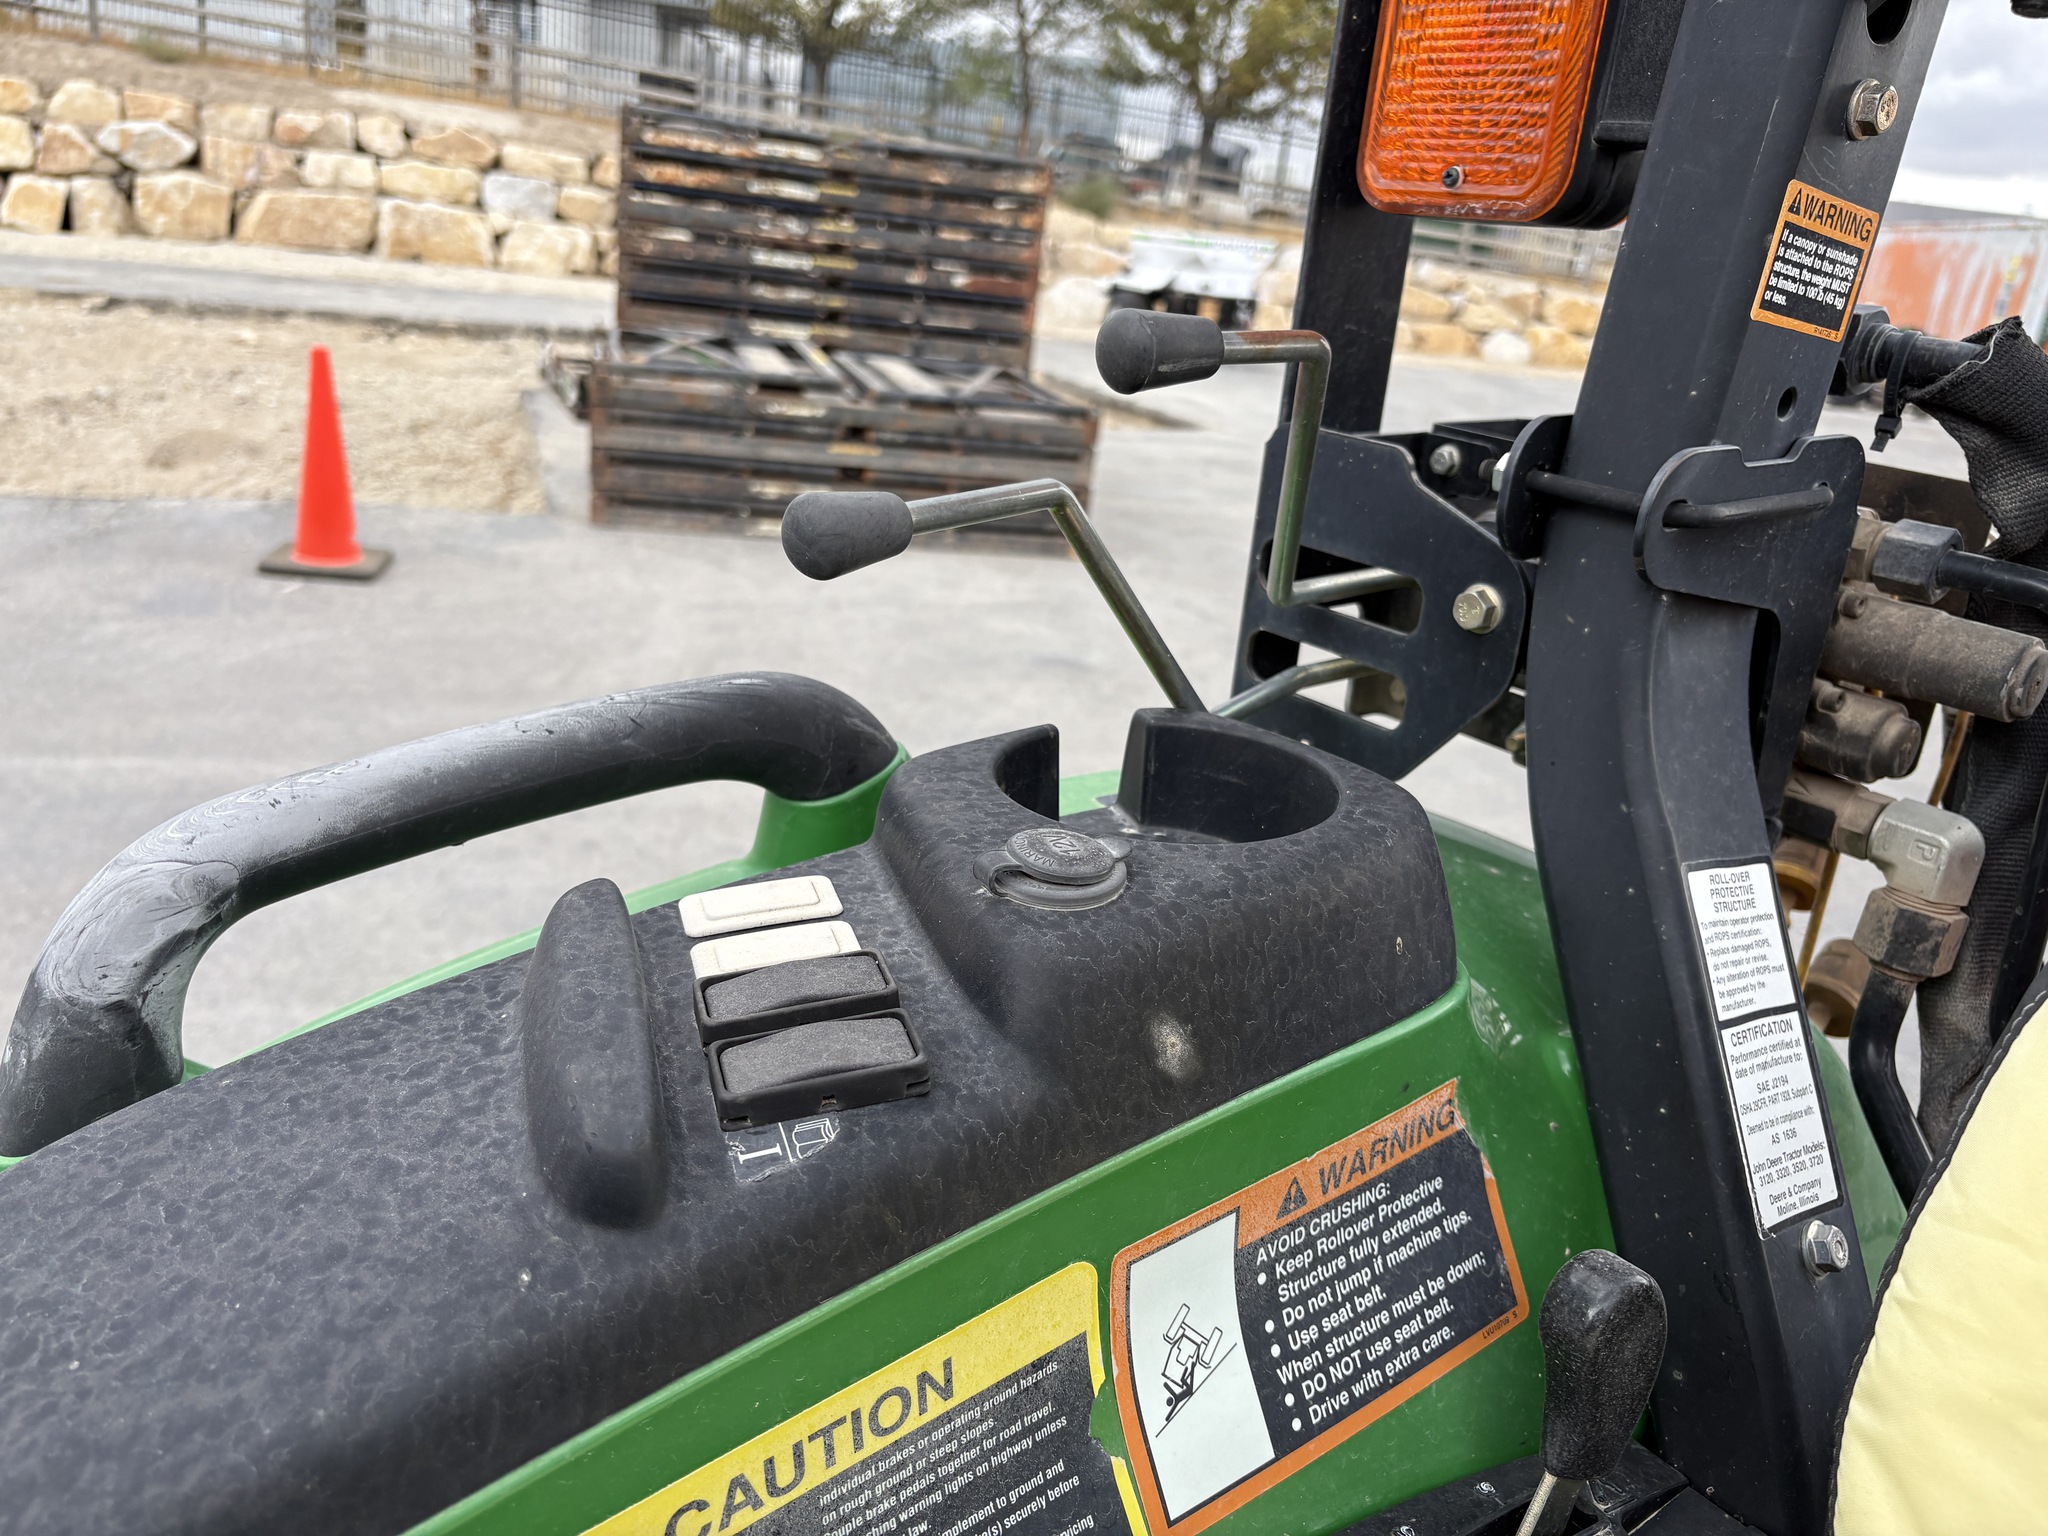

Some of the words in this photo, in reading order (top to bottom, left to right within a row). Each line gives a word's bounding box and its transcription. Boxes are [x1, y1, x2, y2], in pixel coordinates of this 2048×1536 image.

[1804, 194, 1872, 242] WARNING
[1778, 244, 1784, 256] is
[1785, 248, 1814, 266] attached
[1814, 257, 1821, 269] to
[1822, 260, 1833, 273] the
[1834, 264, 1854, 280] ROPS
[1782, 229, 1789, 241] If
[1788, 234, 1793, 243] a
[1793, 236, 1817, 254] canopy
[1818, 243, 1826, 254] or
[1826, 248, 1858, 266] sunshade
[1769, 273, 1777, 286] be
[1777, 276, 1799, 293] limited
[1798, 284, 1805, 295] to
[1806, 286, 1818, 299] 100
[1817, 288, 1824, 301] lb
[1823, 292, 1835, 305] (45
[1834, 295, 1846, 310] kg)
[1773, 261, 1800, 280] structure,
[1801, 268, 1811, 282] the
[1811, 274, 1832, 289] weight
[1831, 278, 1851, 294] MUST
[1764, 291, 1773, 300] or
[1772, 291, 1786, 305] less.
[1014, 834, 1054, 867] MARINCO
[1042, 835, 1081, 854] 12V
[1709, 871, 1750, 885] ROLL-OVER
[1710, 884, 1754, 899] PROTECTIVE
[1701, 922, 1708, 931] To
[1708, 918, 1729, 928] maintain
[1730, 917, 1749, 928] operator
[1750, 912, 1774, 925] protection
[1714, 898, 1756, 913] STRUCTURE
[1705, 934, 1714, 944] and
[1714, 931, 1730, 941] ROPS
[1710, 946, 1730, 958] Replace
[1731, 942, 1754, 953] damaged
[1713, 962, 1720, 971] do
[1721, 961, 1729, 969] not
[1730, 957, 1744, 969] repair
[1752, 953, 1768, 962] revise.
[1716, 976, 1726, 986] Any
[1727, 970, 1749, 982] alteration
[1750, 968, 1755, 977] of
[1756, 965, 1771, 975] ROPS
[1772, 964, 1784, 973] must
[1718, 990, 1725, 999] be
[1726, 983, 1749, 999] approved
[1749, 982, 1756, 992] by
[1757, 981, 1766, 989] the
[1722, 998, 1756, 1012] manufacturer.
[1731, 1018, 1793, 1047] CERTIFICATION
[1730, 1046, 1768, 1065] Performance
[1769, 1038, 1793, 1053] certified
[1794, 1037, 1801, 1048] at
[1735, 1068, 1748, 1079] date
[1749, 1063, 1755, 1075] of
[1756, 1055, 1793, 1072] manufacture
[1794, 1052, 1803, 1063] to:
[1740, 1102, 1753, 1116] OSHA
[1768, 1092, 1780, 1106] PART
[1791, 1085, 1809, 1100] Subpart
[1808, 1083, 1813, 1094] C
[1757, 1080, 1770, 1094] SAE
[1772, 1074, 1788, 1090] J2194
[1747, 1120, 1764, 1135] Deemed
[1764, 1120, 1769, 1129] to
[1769, 1117, 1775, 1128] be
[1780, 1110, 1803, 1124] compliance
[1771, 1132, 1780, 1145] AS
[1319, 1098, 1455, 1195] WARNING
[1752, 1161, 1766, 1175] John
[1766, 1156, 1782, 1169] Deere
[1782, 1148, 1802, 1162] Tractor
[1802, 1140, 1826, 1156] Models:
[1759, 1172, 1775, 1187] 3120,
[1775, 1166, 1792, 1180] 3320,
[1792, 1159, 1809, 1174] 3520,
[1809, 1153, 1824, 1168] 3720
[1769, 1191, 1787, 1205] Deere
[1788, 1187, 1792, 1197] &
[1793, 1178, 1822, 1195] Company
[1777, 1202, 1799, 1217] Moline,
[1799, 1192, 1819, 1208] Illinois
[1256, 1226, 1305, 1266] AVOID
[1310, 1182, 1391, 1236] CRUSHING:
[1275, 1249, 1313, 1280] Keep
[1317, 1212, 1375, 1256] Rollover
[1378, 1176, 1443, 1221] Protective
[1278, 1256, 1347, 1302] Structure
[1349, 1235, 1379, 1263] fully
[1382, 1197, 1446, 1244] extended.
[1282, 1306, 1304, 1327] Do
[1308, 1286, 1334, 1314] not
[1336, 1267, 1371, 1302] jump
[1373, 1258, 1384, 1276] if
[1387, 1228, 1441, 1268] machine
[1442, 1210, 1472, 1240] tips.
[1277, 1349, 1323, 1386] When
[1325, 1309, 1390, 1358] structure
[1392, 1287, 1427, 1317] must
[1427, 1275, 1445, 1296] be
[1447, 1251, 1486, 1283] down;
[1288, 1326, 1319, 1351] Use
[1322, 1304, 1354, 1332] seat
[1356, 1284, 1386, 1312] belt.
[1512, 1310, 1517, 1318] S
[1302, 1372, 1327, 1400] DO
[1330, 1349, 1363, 1383] NOT
[1367, 1336, 1392, 1362] use
[1394, 1313, 1424, 1344] seat
[1426, 1296, 1454, 1324] belt.
[1309, 1392, 1350, 1425] Drive
[1351, 1369, 1383, 1398] with
[1385, 1347, 1420, 1376] extra
[1423, 1326, 1455, 1354] care.
[664, 1356, 954, 1536] CAUTION
[820, 1466, 875, 1506] individual
[878, 1444, 915, 1473] brakes
[917, 1436, 929, 1449] or
[932, 1406, 980, 1441] operating
[983, 1383, 1018, 1411] around
[1020, 1361, 1057, 1390] hazards
[822, 1510, 837, 1525] on
[840, 1489, 872, 1516] rough
[875, 1464, 913, 1496] ground
[916, 1457, 927, 1471] or
[929, 1440, 958, 1462] steep
[960, 1417, 997, 1444] slopes.
[866, 1495, 897, 1520] brake
[900, 1472, 936, 1502] pedals
[937, 1445, 980, 1477] together
[982, 1436, 997, 1451] for
[1000, 1419, 1021, 1442] road
[1024, 1401, 1056, 1426] travel.
[899, 1490, 943, 1522] warning
[944, 1471, 974, 1495] lights
[976, 1462, 989, 1476] on
[990, 1435, 1033, 1468] highway
[1035, 1416, 1067, 1441] unless
[996, 1496, 1007, 1509] to
[1009, 1471, 1044, 1504] ground
[1046, 1458, 1065, 1480] and
[1003, 1494, 1047, 1528] securely
[1048, 1475, 1080, 1502] before
[908, 1520, 931, 1536] law.
